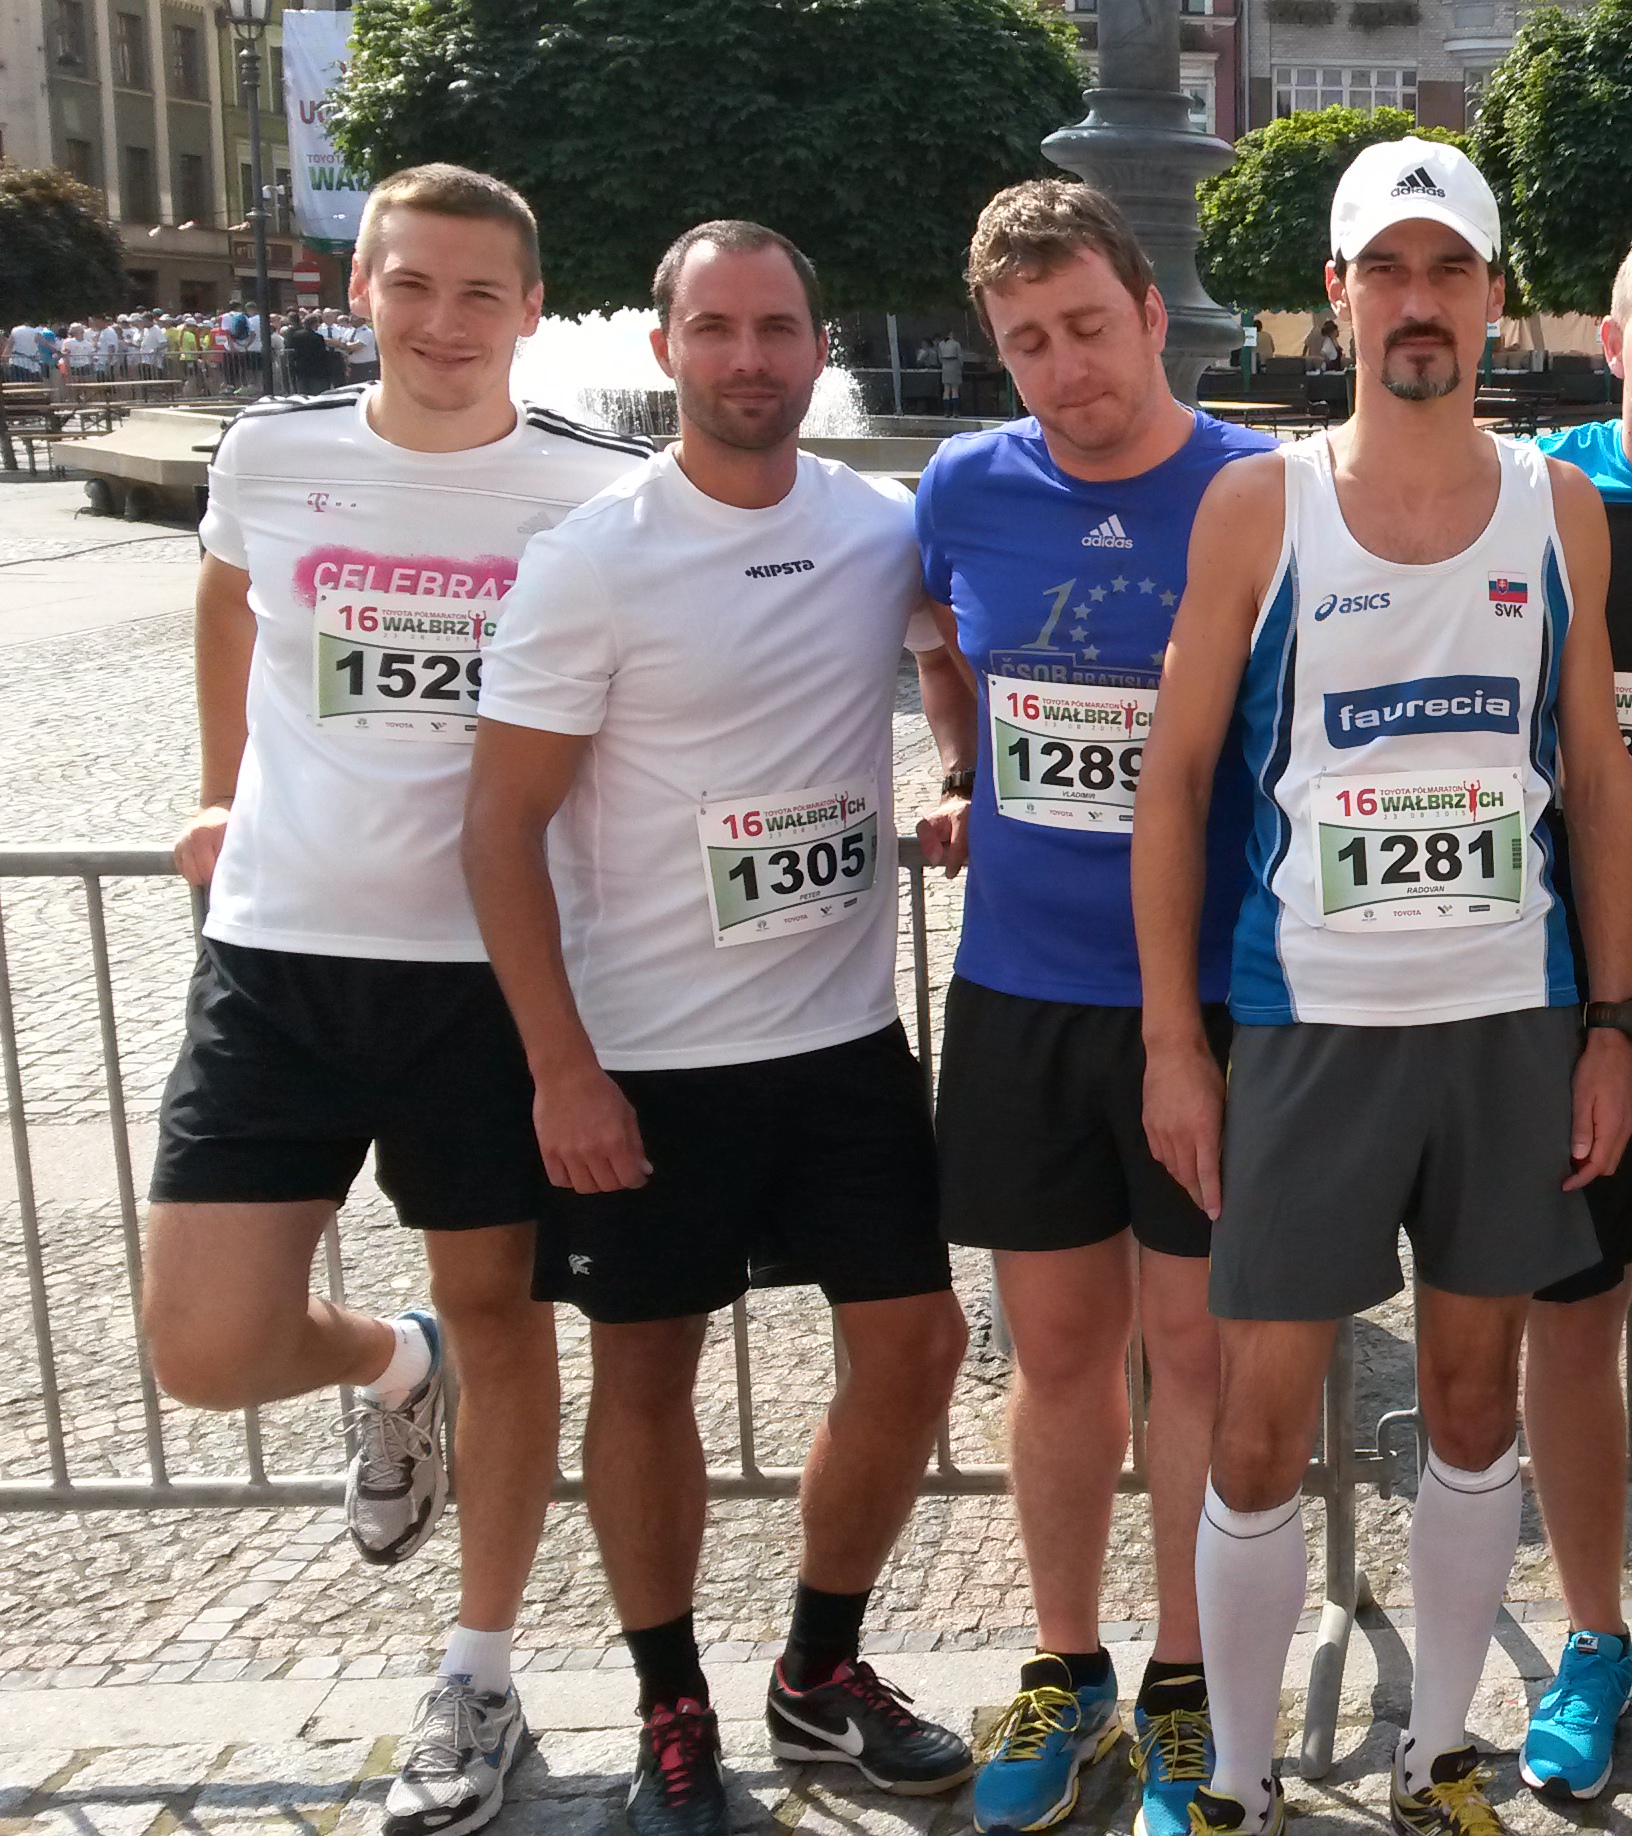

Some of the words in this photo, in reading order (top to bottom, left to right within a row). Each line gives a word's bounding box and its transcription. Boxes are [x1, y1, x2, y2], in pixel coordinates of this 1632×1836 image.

[308, 166, 369, 191] WA
[1390, 186, 1446, 198] adidas
[1081, 535, 1134, 549] adidas
[1020, 577, 1077, 650] 1
[1338, 592, 1391, 614] asics
[1494, 602, 1524, 619] SVK
[338, 605, 379, 632] 16
[382, 616, 497, 637] WAŁBRZYC
[1073, 670, 1160, 689] BRATISLA
[1006, 692, 1041, 721] 16
[1338, 689, 1511, 732] faurecia
[1008, 736, 1143, 793] 1289
[1336, 788, 1378, 817] 16
[722, 810, 763, 840] 16
[729, 832, 866, 902] 1305
[1338, 829, 1495, 886] 1281
[800, 890, 822, 901] PETER
[1407, 885, 1446, 894] RADOVAN
[1393, 909, 1422, 917] TOYOTA
